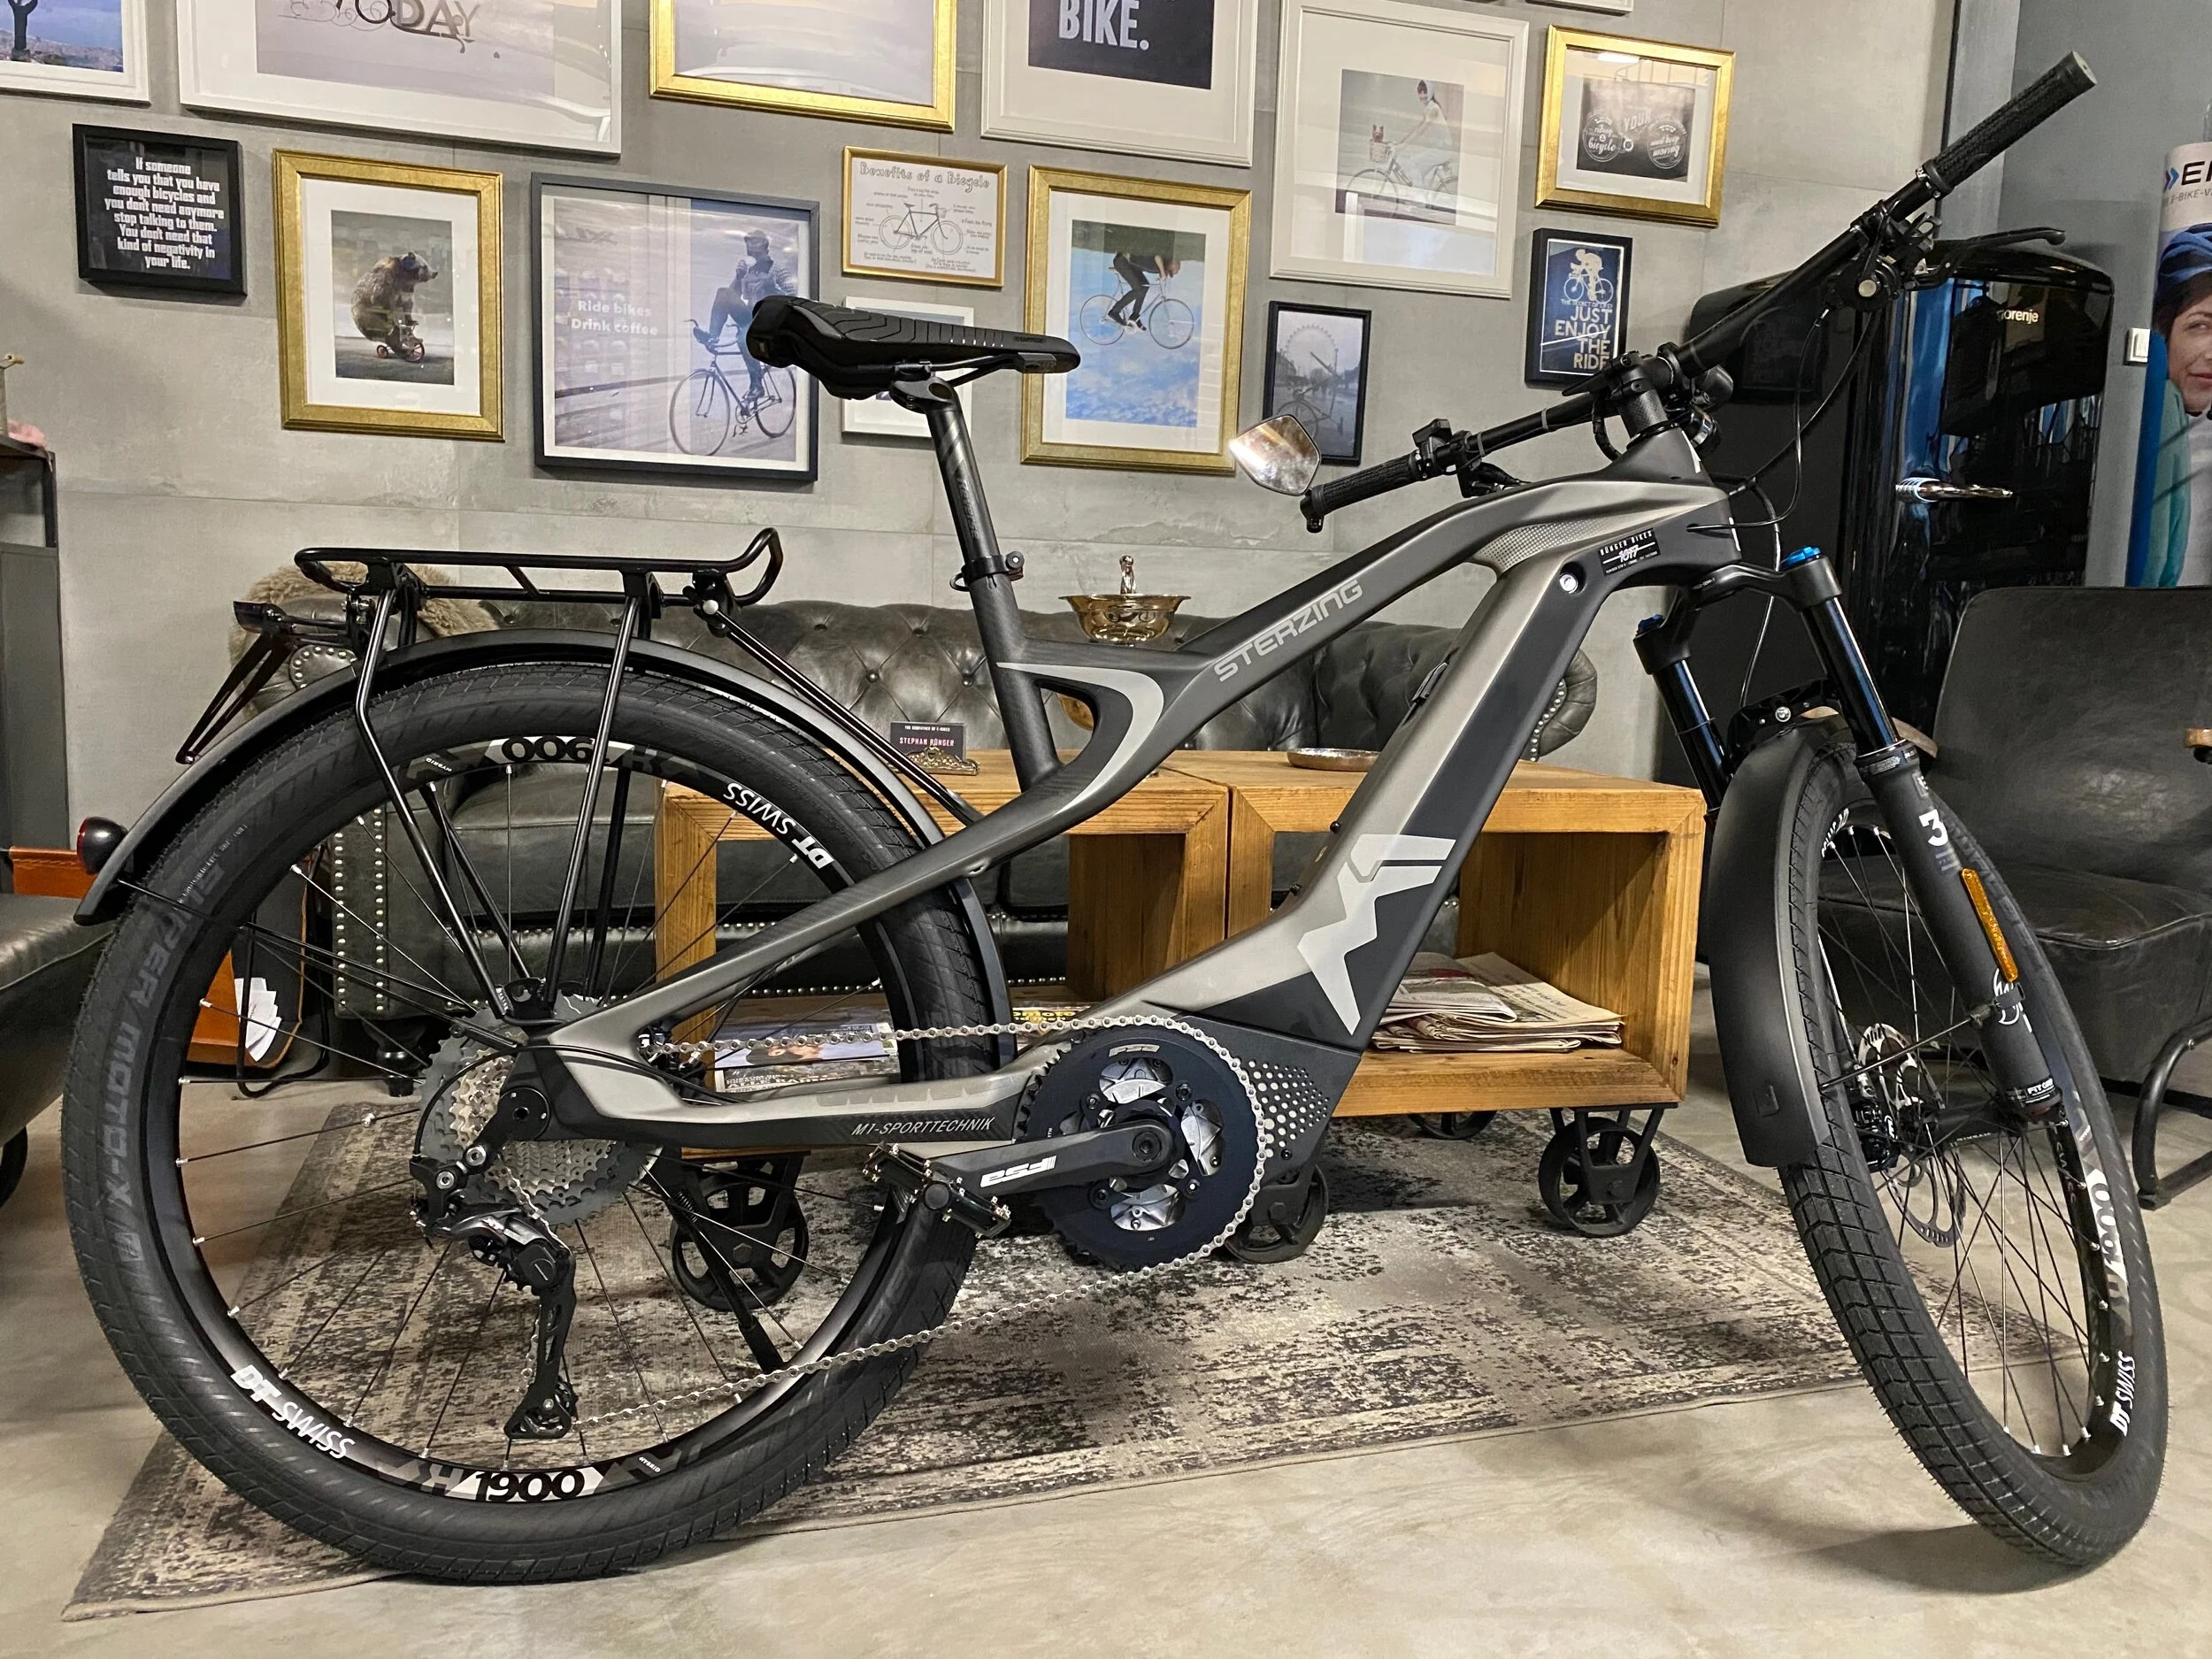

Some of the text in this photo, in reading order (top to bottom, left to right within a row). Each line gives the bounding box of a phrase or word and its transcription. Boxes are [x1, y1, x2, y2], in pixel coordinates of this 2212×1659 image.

[336, 0, 479, 37] ODAY
[1058, 0, 1149, 50] BIKE.
[135, 157, 191, 174] If someone
[2181, 161, 2212, 186] E
[107, 169, 219, 191] tells you that you have
[860, 161, 912, 180] Benefits
[917, 169, 930, 182] of
[934, 174, 943, 183] a
[947, 171, 989, 193] Bicycle
[113, 185, 215, 204] enough bicycles and
[2170, 188, 2212, 204] E-BIKE-V
[104, 198, 124, 210] you
[152, 202, 176, 214] need
[179, 206, 224, 220] anymore
[114, 212, 217, 232] stop talking to them.
[119, 224, 138, 237] You
[165, 230, 189, 242] need
[192, 231, 212, 244] that
[118, 237, 215, 259] kind of negativity in
[145, 256, 190, 269] your life.
[578, 300, 652, 317] Ride bikes
[1571, 306, 1612, 324] JUST
[571, 318, 658, 335] Drink coffee
[1555, 319, 1611, 340] ENJOY
[1577, 338, 1610, 355] THE
[1631, 531, 1652, 543] BIKES
[1213, 579, 1363, 682] STERZING
[723, 782, 834, 869] DT SWISS
[851, 1117, 995, 1136] M1-SPORTTECHNIK
[2109, 1350, 2135, 1437] DT SWISS
[230, 1364, 355, 1459] DT SWISS
[638, 1456, 661, 1473] HYBRID
[475, 1470, 586, 1502] 1900
